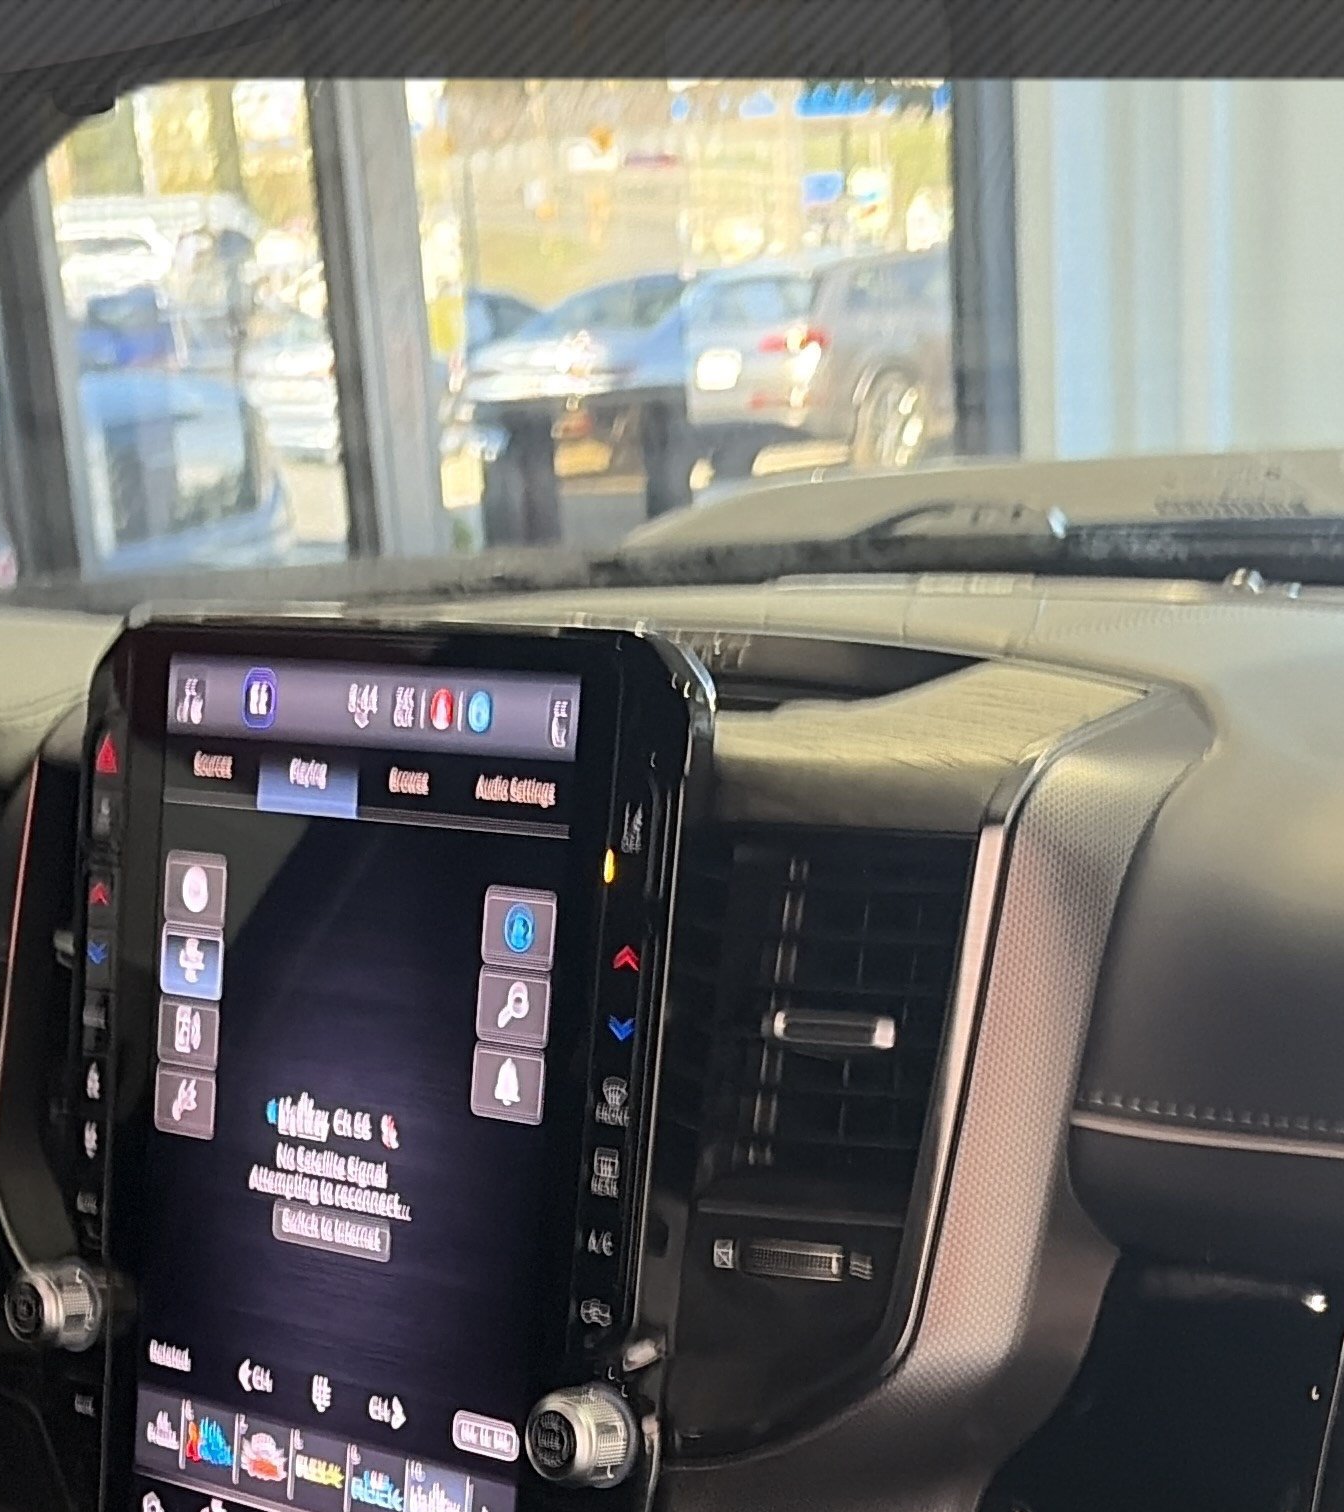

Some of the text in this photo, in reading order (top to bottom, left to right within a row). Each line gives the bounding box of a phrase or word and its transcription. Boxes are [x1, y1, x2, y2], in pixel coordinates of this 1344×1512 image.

[475, 774, 556, 809] Audio Settings
[276, 1142, 296, 1171] No
[347, 1155, 388, 1189] Signal
[149, 1338, 192, 1373] Related
